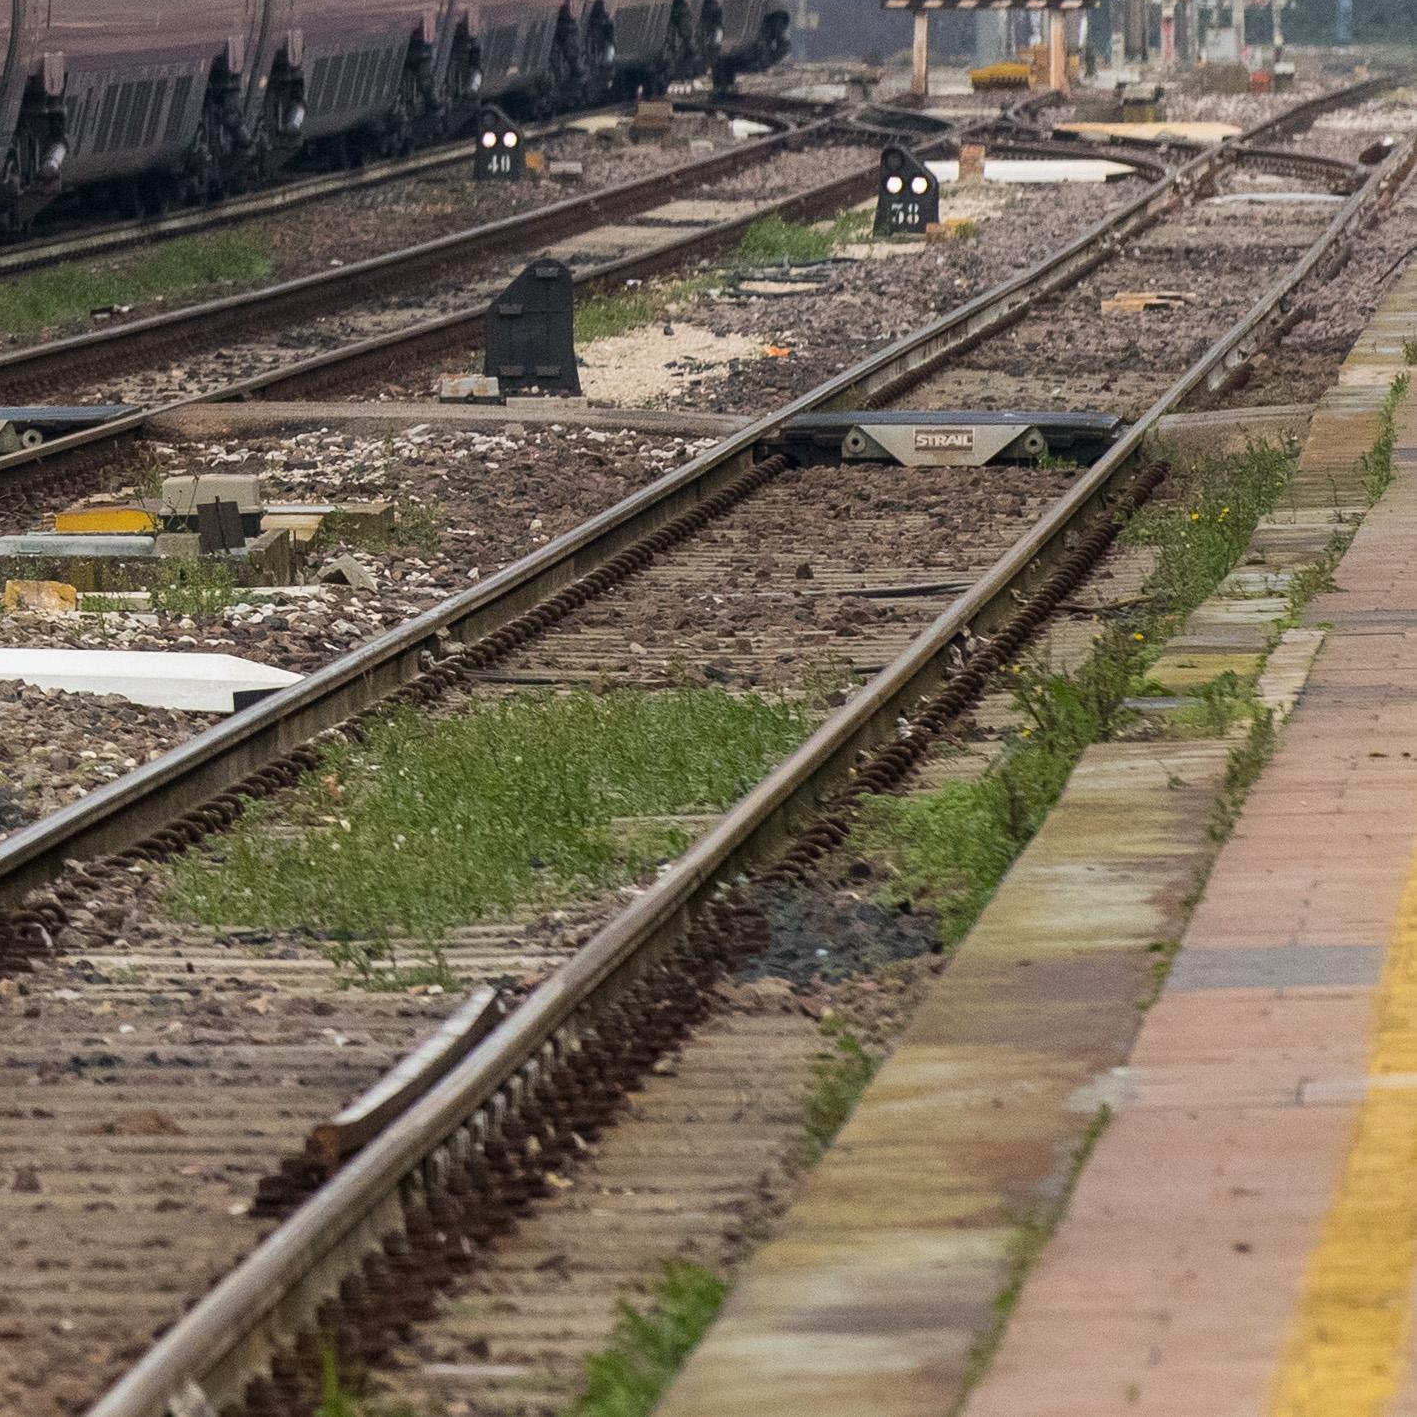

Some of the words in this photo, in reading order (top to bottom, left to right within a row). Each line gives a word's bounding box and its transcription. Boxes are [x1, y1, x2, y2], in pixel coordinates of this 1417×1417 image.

[487, 154, 511, 173] 40
[891, 203, 920, 224] 38
[916, 434, 973, 447] STRAIL
